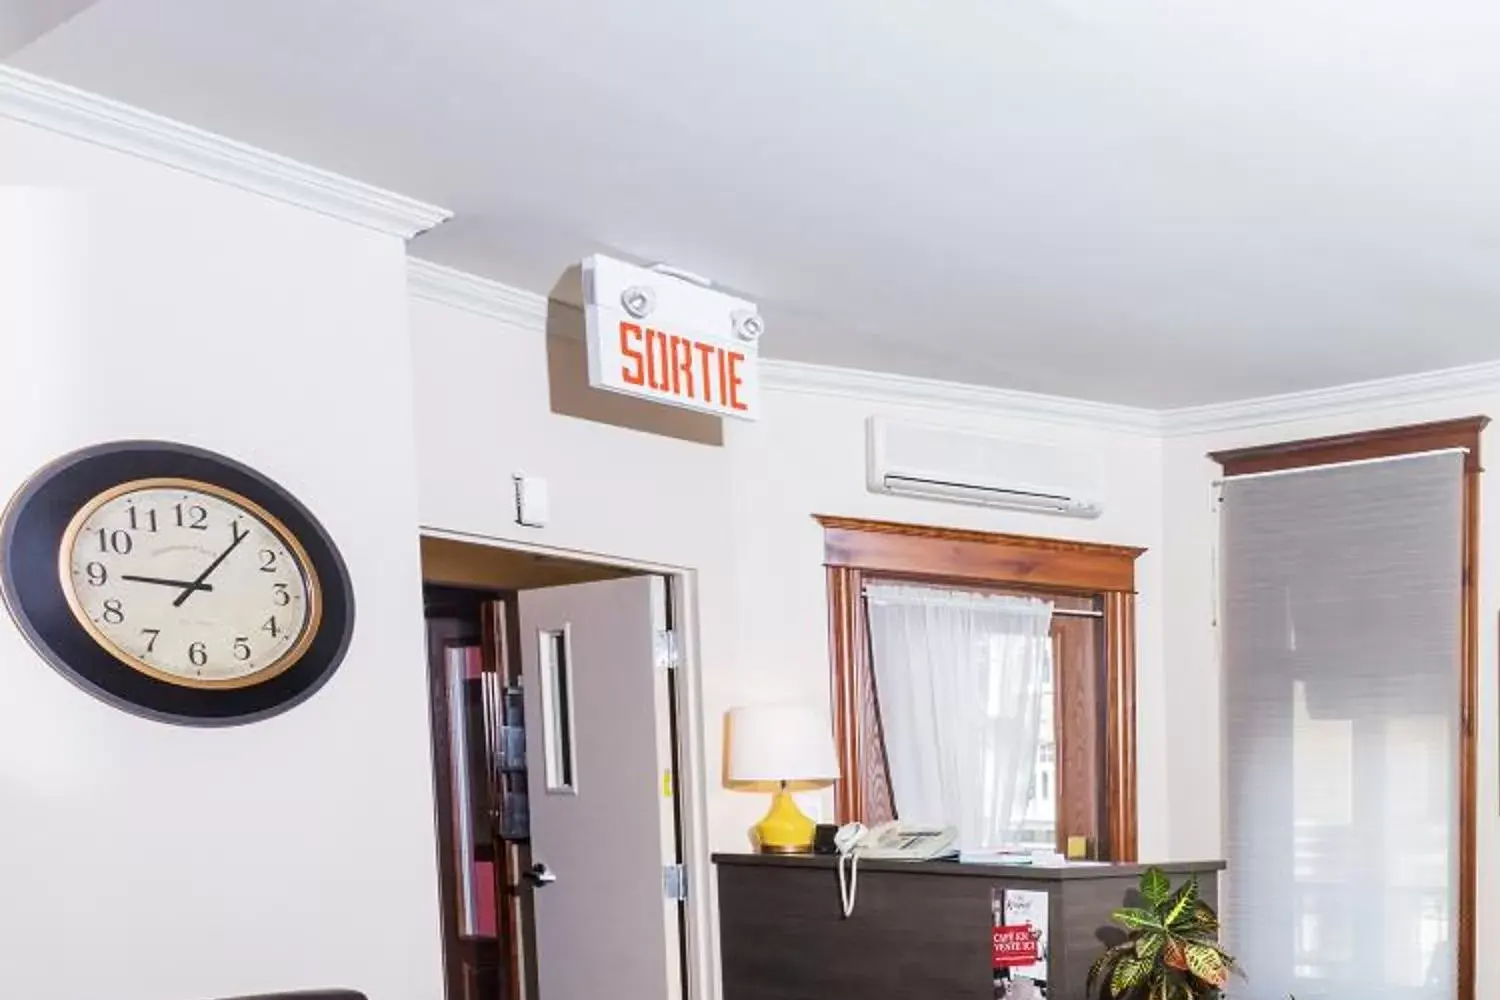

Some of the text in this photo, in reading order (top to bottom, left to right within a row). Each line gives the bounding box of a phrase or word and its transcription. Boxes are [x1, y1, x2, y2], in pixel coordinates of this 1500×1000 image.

[619, 320, 748, 411] SORTIE
[127, 505, 157, 533] 11
[173, 503, 208, 531] 12
[98, 528, 133, 555] 10
[231, 519, 241, 545] 1
[87, 561, 107, 587] 9
[259, 549, 277, 573] 2
[273, 583, 290, 607] 3
[103, 599, 125, 625] 8
[263, 615, 280, 638] 4
[141, 628, 160, 652] 7
[233, 636, 252, 661] 5
[189, 642, 208, 667] 6
